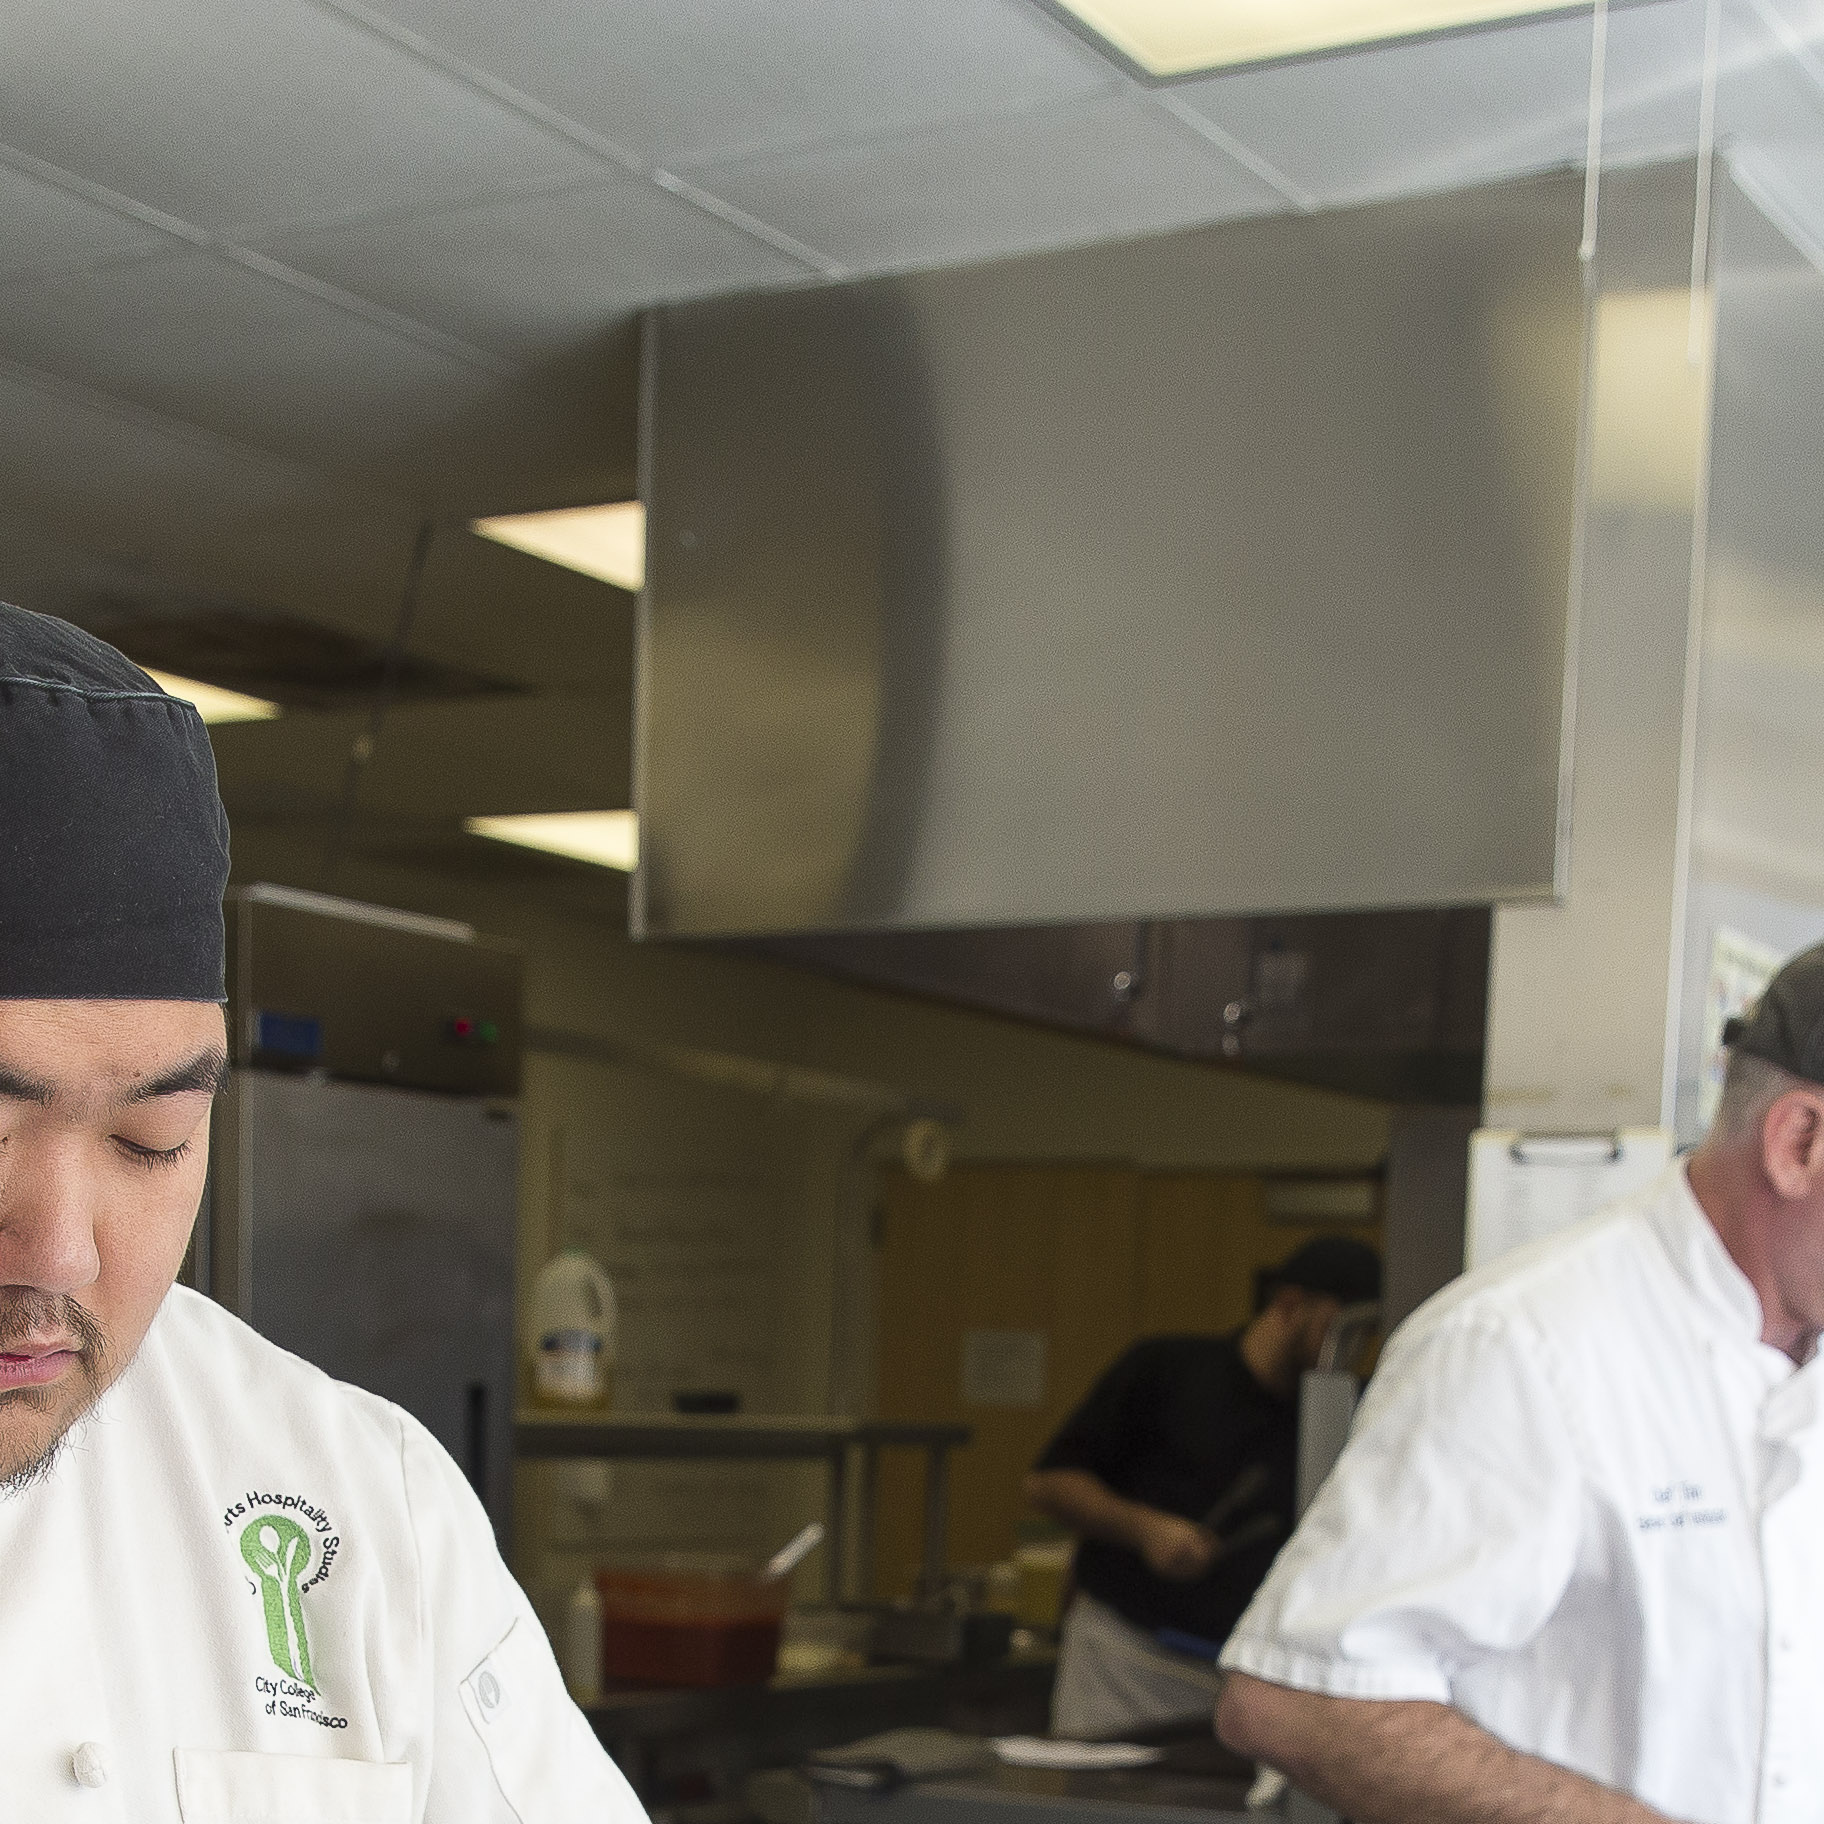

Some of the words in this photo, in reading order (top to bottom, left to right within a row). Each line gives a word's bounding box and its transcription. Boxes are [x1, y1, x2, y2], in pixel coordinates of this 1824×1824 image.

[224, 1502, 246, 1534] rts
[255, 1676, 278, 1697] City
[265, 1700, 276, 1715] of
[279, 1700, 302, 1718] San
